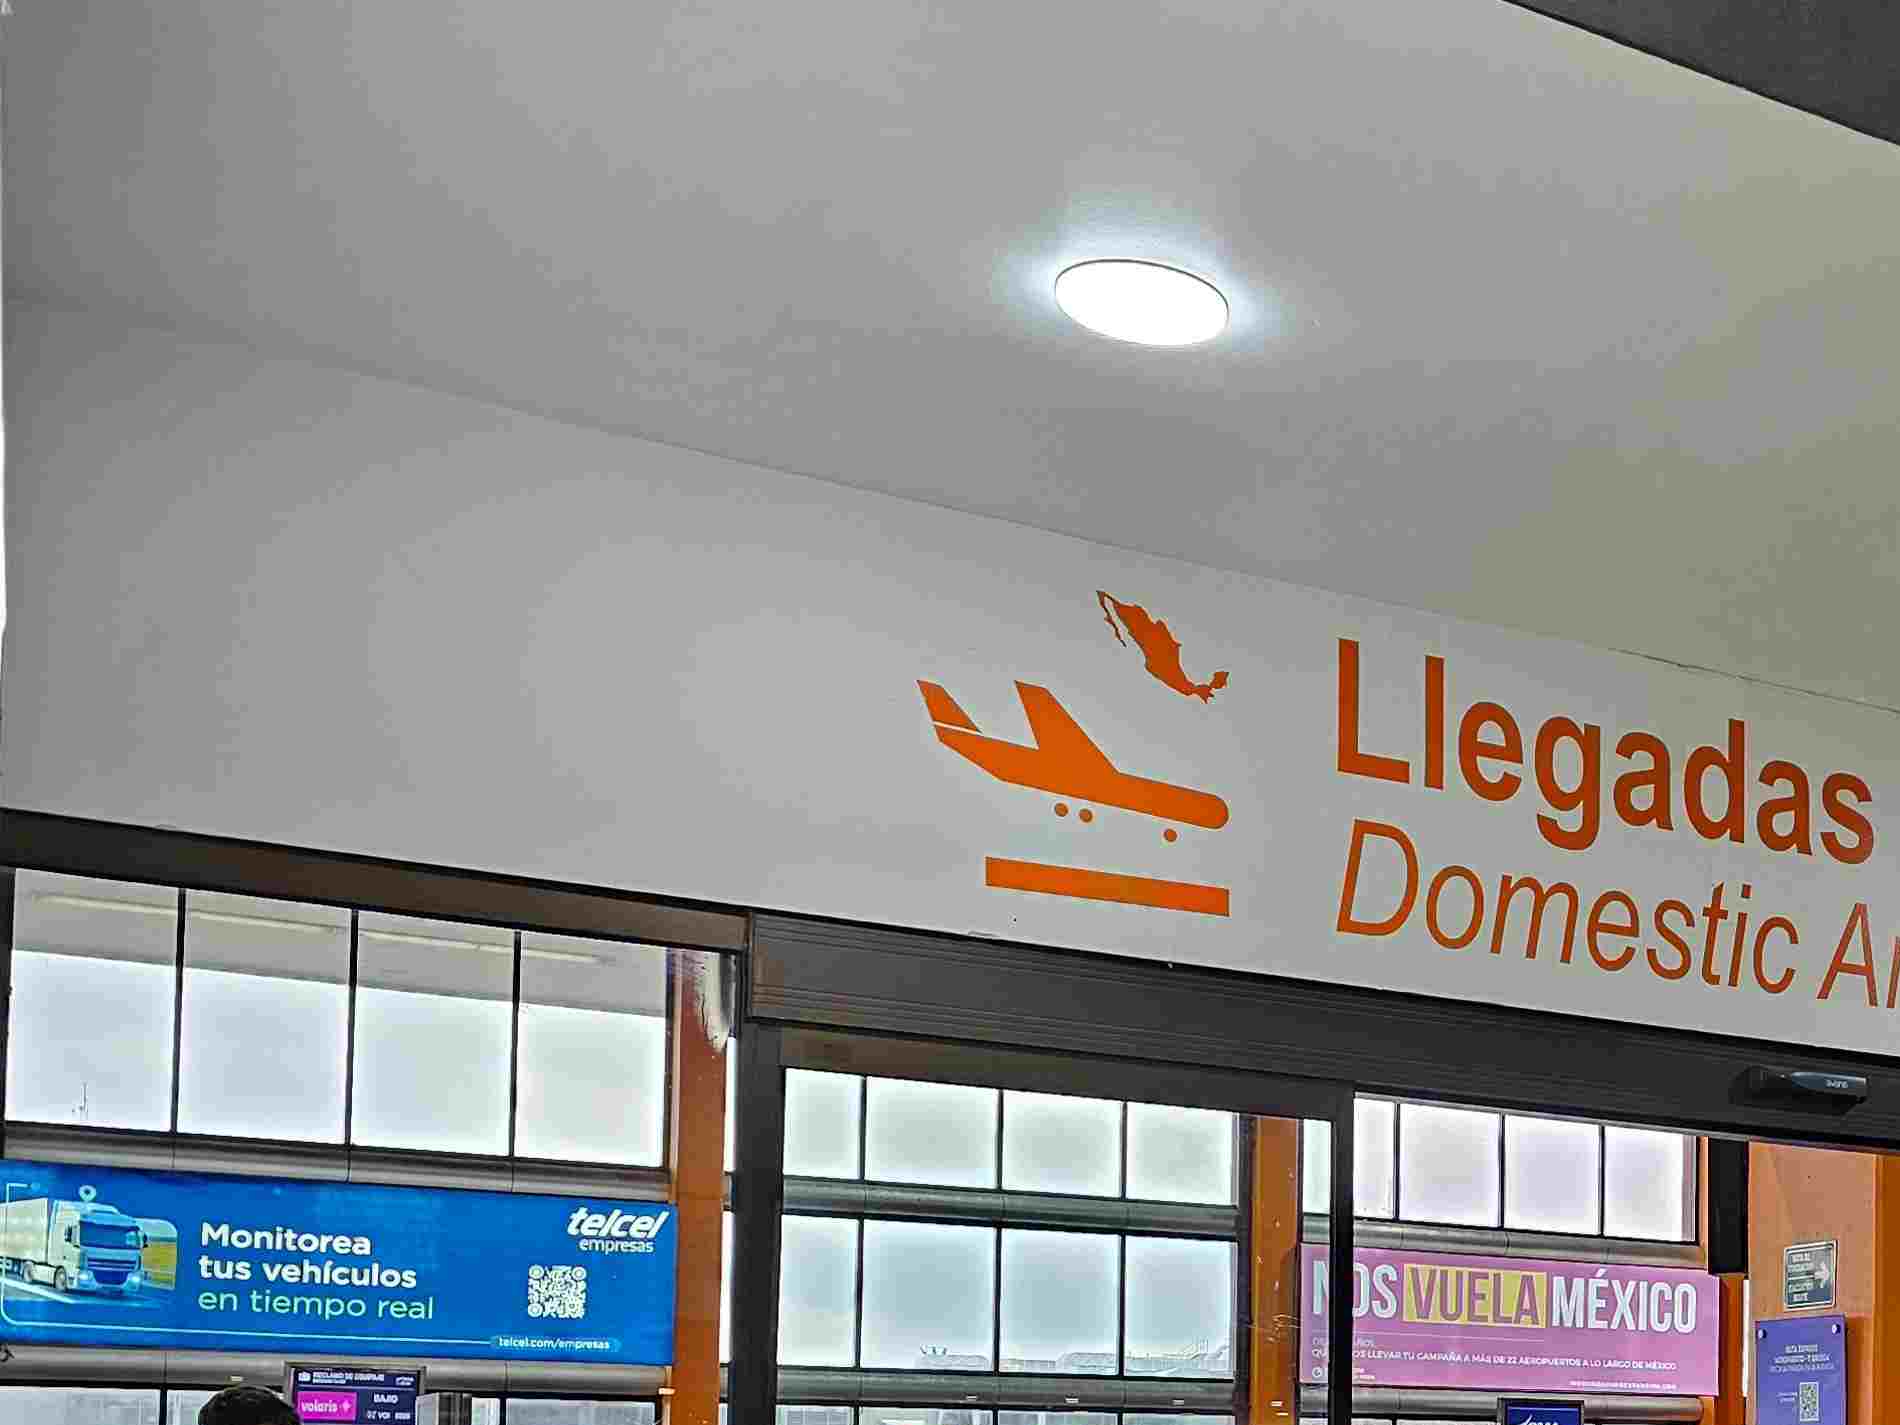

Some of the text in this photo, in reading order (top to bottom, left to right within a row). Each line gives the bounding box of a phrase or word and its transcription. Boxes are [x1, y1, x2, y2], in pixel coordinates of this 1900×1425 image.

[1336, 638, 1874, 866] Llegadas
[1336, 818, 1799, 995] Domestic
[200, 1222, 371, 1256] Monitorea
[566, 1206, 670, 1239] telcel
[578, 1237, 655, 1255] empresas
[198, 1255, 418, 1289] tus vehículos
[198, 1289, 434, 1321] en tiempo real
[1408, 1266, 1542, 1327] VUELA
[1551, 1268, 1698, 1334] MÉXICO
[499, 1336, 611, 1351] telcel.com/empresas
[301, 1399, 338, 1413] volaris
